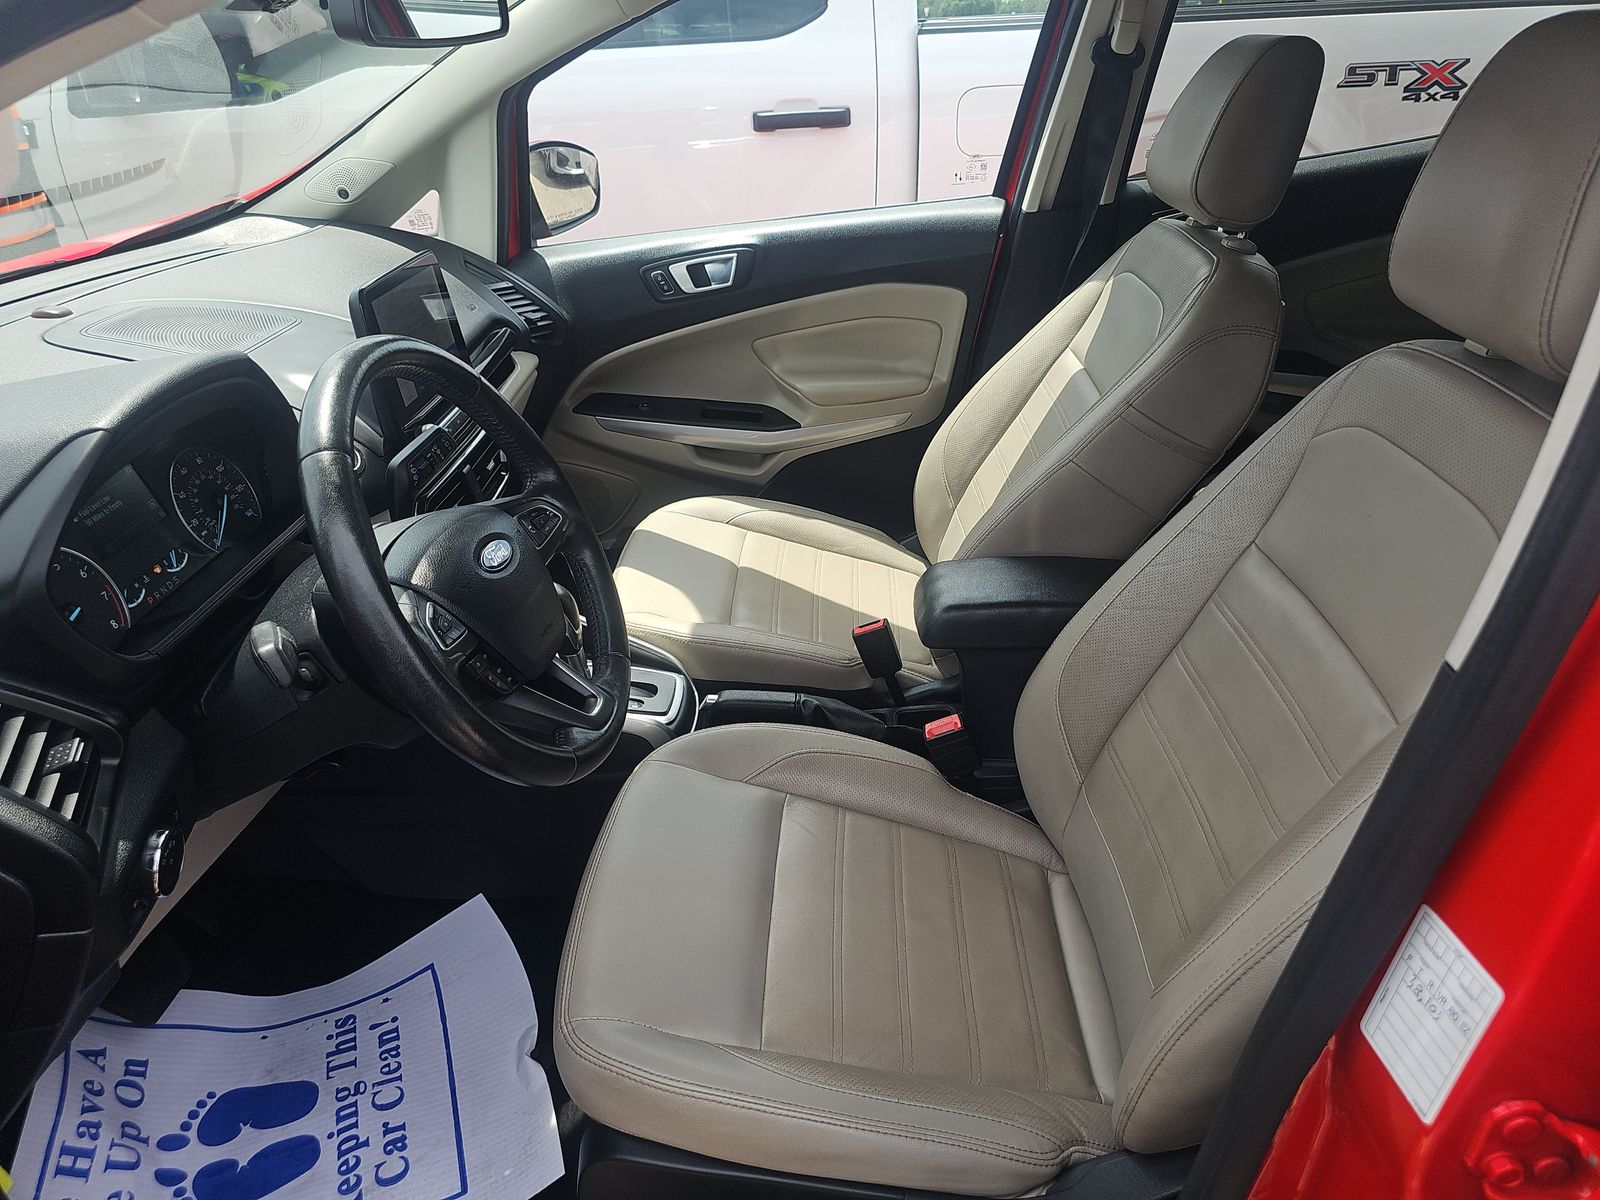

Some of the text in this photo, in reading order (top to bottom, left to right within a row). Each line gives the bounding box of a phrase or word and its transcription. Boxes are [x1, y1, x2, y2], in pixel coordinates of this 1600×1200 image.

[1336, 57, 1471, 93] STX
[1401, 91, 1460, 102] 4x4
[80, 568, 88, 578] 6
[110, 619, 119, 629] 8
[76, 1046, 107, 1073] A
[325, 1013, 358, 1080] This
[114, 1058, 149, 1108] On
[369, 1015, 410, 1187] Car Clean!
[54, 1079, 105, 1183] Have
[104, 1120, 150, 1173] Up
